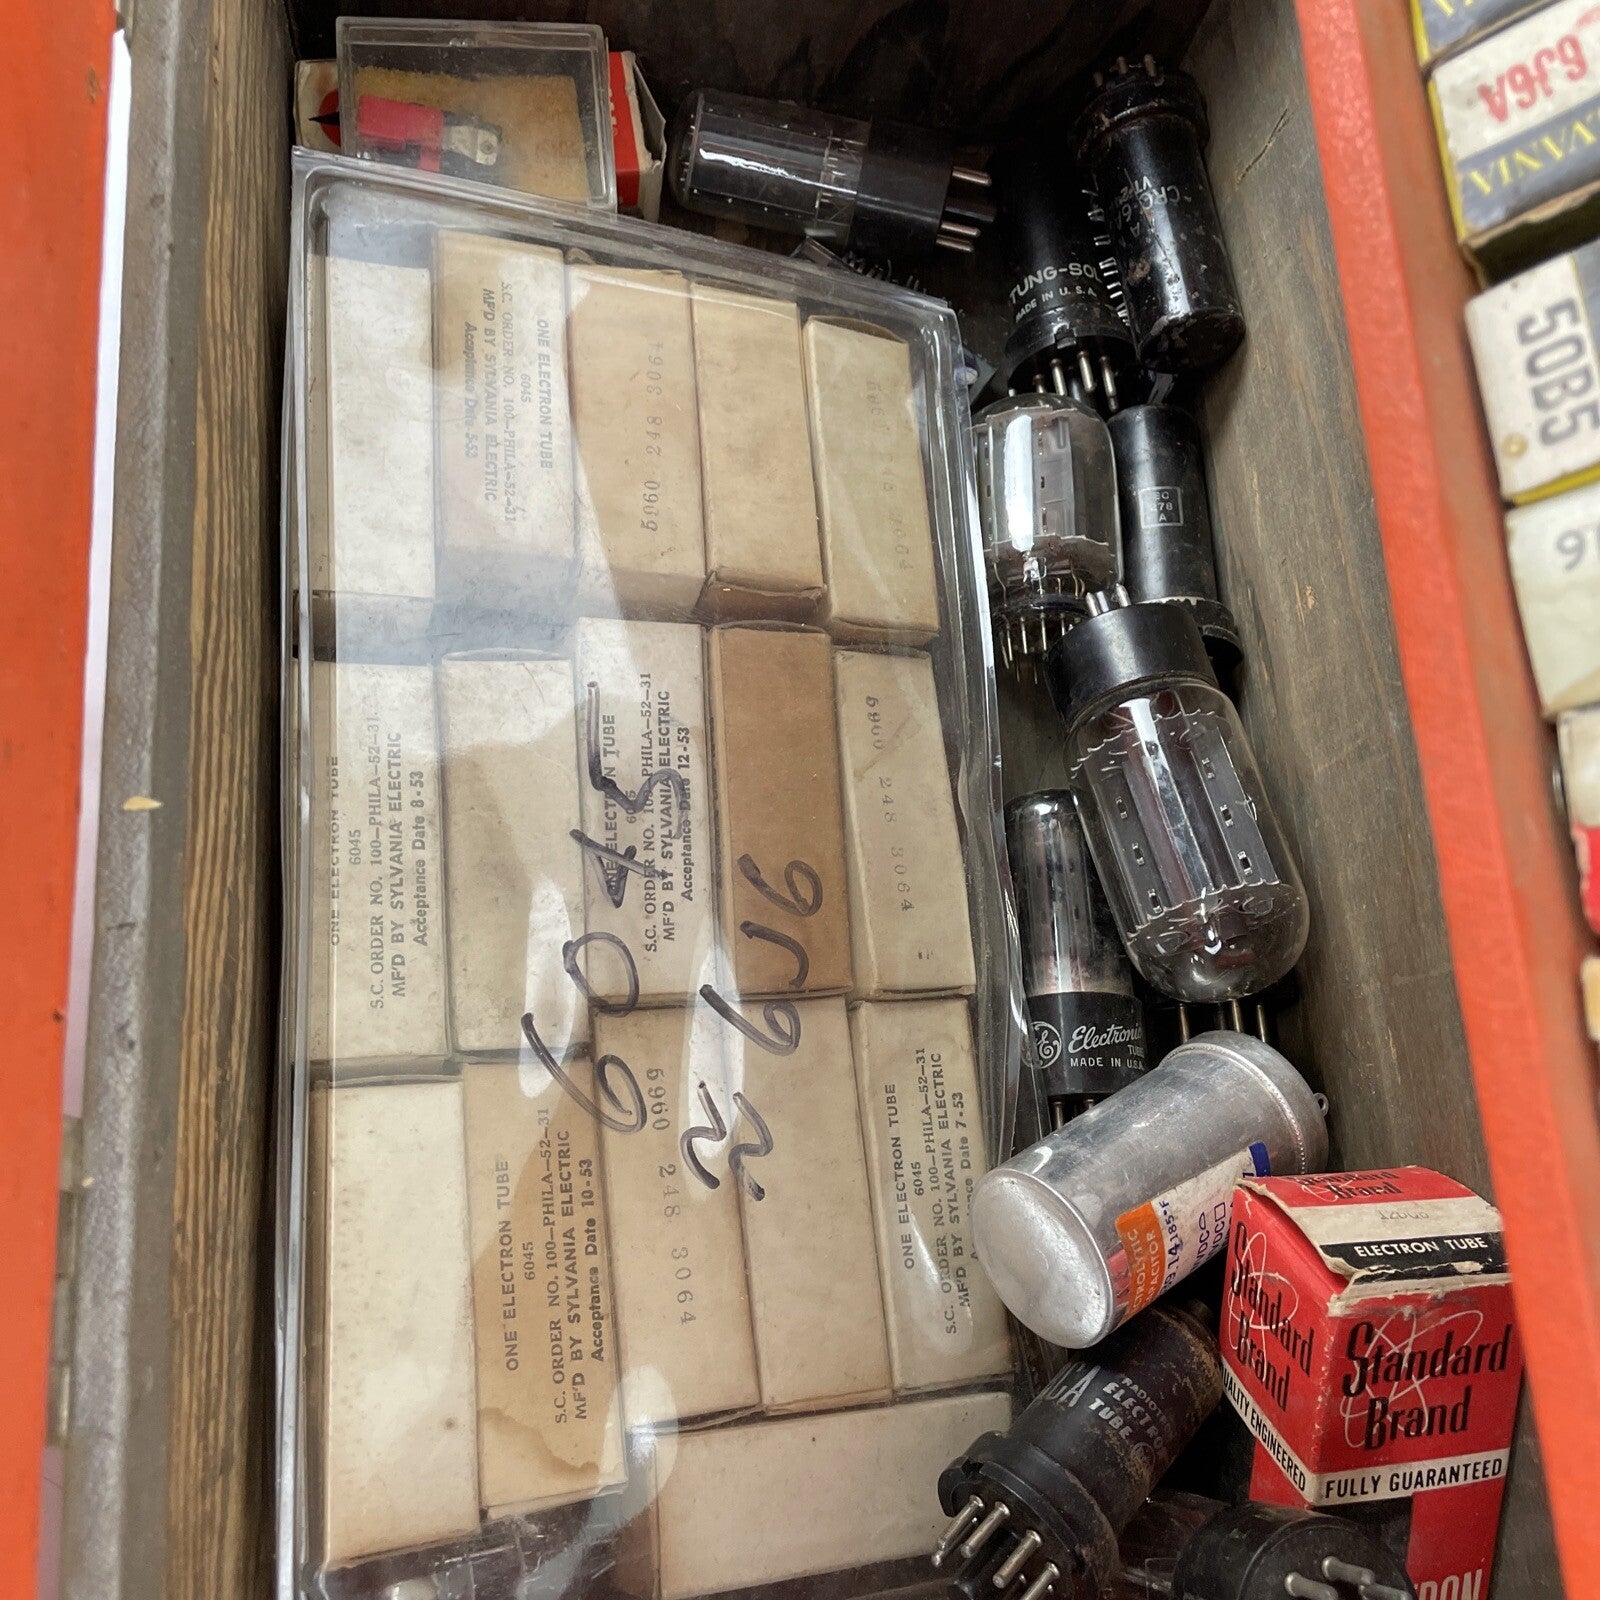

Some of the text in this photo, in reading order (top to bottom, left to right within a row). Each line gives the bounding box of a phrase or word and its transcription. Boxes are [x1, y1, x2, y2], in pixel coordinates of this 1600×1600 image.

[1477, 34, 1588, 123] 6J6A
[1469, 107, 1600, 195] VANIA
[1008, 262, 1102, 304] TUNG-SOL
[1015, 298, 1037, 324] MADE
[1041, 290, 1054, 303] IN
[464, 321, 477, 393] Acceptance
[484, 327, 496, 347] BY
[502, 312, 513, 357] ORDER
[484, 350, 497, 426] SYLVANIA
[503, 364, 514, 388] NO.
[520, 373, 531, 403] 6045
[537, 318, 553, 469] ONE ELECTRON TUBE
[1517, 299, 1600, 446] 50B5
[464, 400, 477, 426] Date
[645, 416, 663, 457] 248
[485, 433, 498, 501] ELECTRIC
[1159, 512, 1167, 521] A
[603, 715, 616, 762] TUBE
[658, 691, 671, 767] ELECTRIC
[411, 815, 426, 851] Date
[603, 766, 618, 854] ELECTN
[626, 790, 637, 824] 605
[660, 776, 674, 860] SYLVANIA
[349, 829, 361, 867] 6045
[643, 823, 655, 851] NO.
[680, 817, 694, 902] Acceptance
[878, 776, 898, 823] 248
[890, 846, 915, 911] 3064
[370, 875, 383, 906] NO.
[387, 732, 406, 998] MF'D BY SYLVANIA ELECTRIC
[644, 858, 657, 915] ORDER
[411, 860, 429, 947] Acceptance
[521, 681, 686, 1135] 6045
[662, 900, 675, 941] MF'D
[371, 914, 384, 975] ORDER
[645, 924, 657, 952] S.C.
[370, 982, 384, 1009] S.C.
[1070, 1057, 1104, 1067] MADE
[1111, 1057, 1121, 1067] IN
[885, 1083, 915, 1270] ONE ELECTRON TUBE
[911, 1161, 924, 1197] 6045
[960, 1137, 972, 1170] Date
[931, 1053, 971, 1308] MF'D BY SYLVANIA ELECTRIC
[585, 1218, 598, 1256] Date
[931, 1197, 945, 1228] NO.
[496, 1161, 519, 1371] ONE ELECTRON TUBE
[522, 1242, 535, 1281] 6045
[658, 1163, 681, 1218] 248
[671, 1246, 697, 1325] 3064
[937, 1237, 952, 1294] ORDER
[1354, 1237, 1488, 1258] ELECTRON TUBE
[548, 1273, 561, 1308] NO.
[557, 1131, 587, 1420] MF'D BY SYLVANIA ELECTRIC
[1231, 1220, 1314, 1378] Standard
[589, 1266, 605, 1362] Acceptance
[945, 1305, 957, 1334] S.C.
[550, 1318, 565, 1385] ORDER
[1237, 1309, 1290, 1412] Brand
[1342, 1321, 1513, 1398] Standard
[555, 1392, 568, 1424] S.C.
[1088, 1398, 1133, 1440] TUBE
[1219, 1359, 1306, 1491] UALITY ENGINEERED
[1364, 1386, 1472, 1453] Brand
[1325, 1458, 1503, 1499] FULLY GUARANTEED
